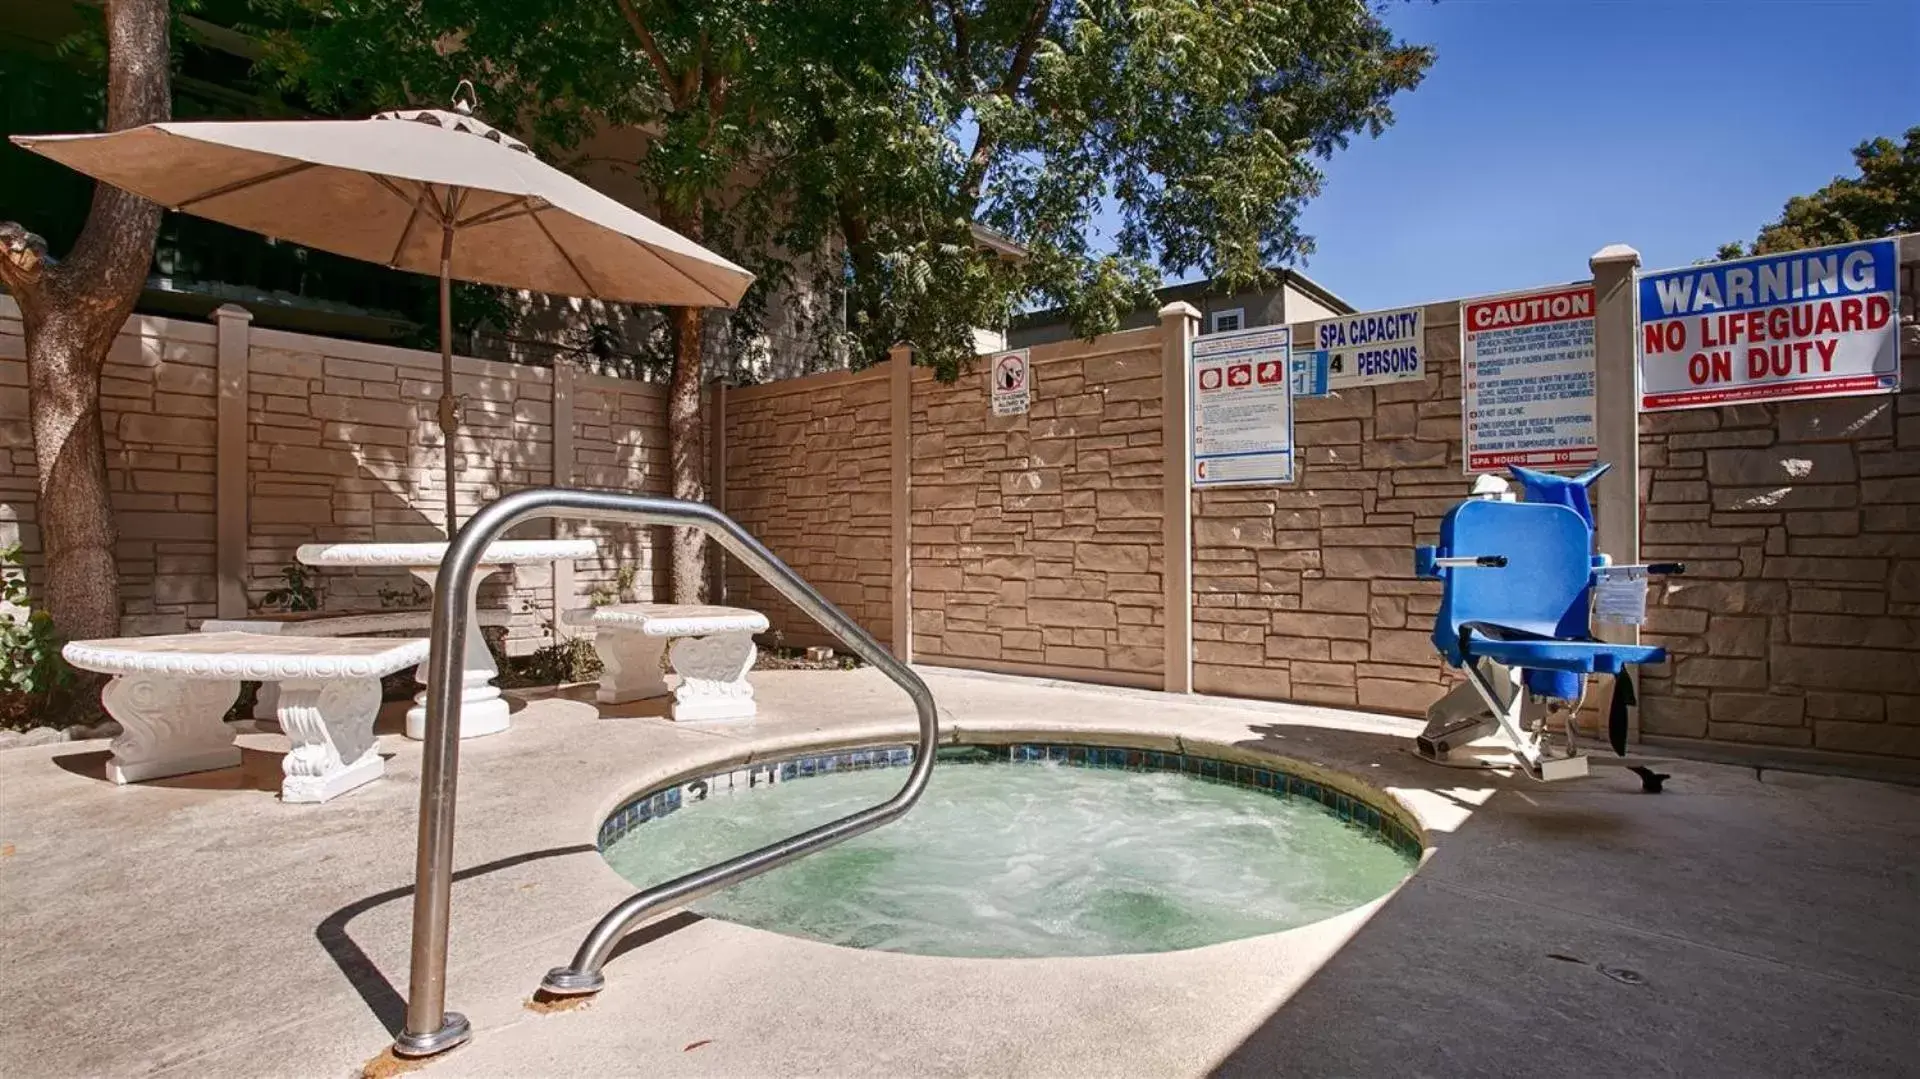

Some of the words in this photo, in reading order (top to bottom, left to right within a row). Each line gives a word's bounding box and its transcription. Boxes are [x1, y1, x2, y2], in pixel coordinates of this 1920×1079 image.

[1655, 250, 1876, 314] WARNING
[1475, 293, 1589, 327] CAUTION
[1645, 321, 1686, 353] NO
[1702, 296, 1890, 347] LIFEGUARD
[1320, 322, 1346, 349] SPA
[1350, 311, 1418, 344] CAPACITY
[1330, 353, 1343, 373] 4
[1358, 346, 1418, 376] PERSONS
[1688, 351, 1731, 385] ON
[1748, 339, 1838, 379] DUTY
[1472, 457, 1490, 465] SPA
[1494, 454, 1526, 464] HOURS
[1556, 452, 1568, 460] TO
